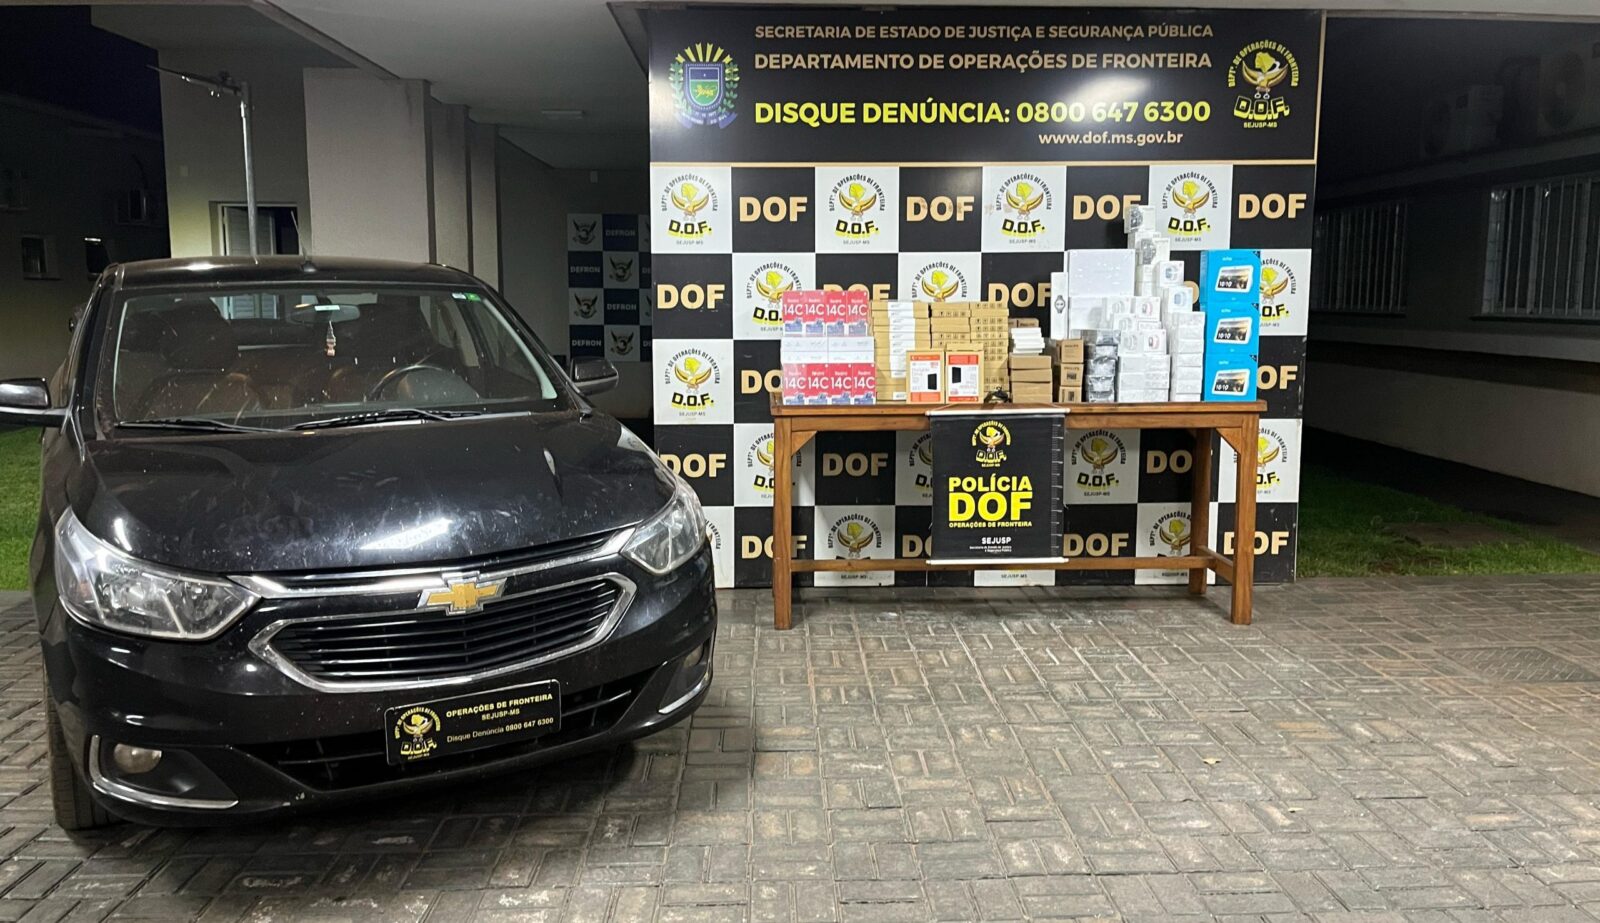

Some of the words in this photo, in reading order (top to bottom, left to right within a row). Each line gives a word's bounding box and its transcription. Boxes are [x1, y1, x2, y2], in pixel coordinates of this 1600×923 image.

[755, 26, 851, 38] SECRETARIA
[855, 26, 876, 38] DE
[879, 26, 941, 38] ESTADO
[944, 26, 965, 38] DE
[968, 26, 1032, 41] JUSTIÇA
[1036, 26, 1045, 38] E
[1049, 25, 1144, 41] SEGURANÇA
[1148, 22, 1213, 38] PÚBLICA
[755, 54, 914, 69] DEPARTAMENTO
[919, 54, 944, 69] DE
[949, 50, 1067, 73] OPERAÇÕES
[1071, 53, 1097, 68] DE
[1102, 53, 1212, 68] FRONTEIRA
[1233, 55, 1242, 65] DE
[1240, 40, 1277, 57] OPERAÇÕES
[1276, 44, 1286, 54] DE
[755, 102, 855, 127] DISQUE
[863, 97, 1010, 123] DENÚNCIA:
[1017, 102, 1085, 123] 0800
[1091, 102, 1138, 122] 647
[1144, 101, 1211, 122] 6300
[1039, 131, 1183, 146] www.dof.ms.gov.br
[740, 197, 807, 222] DOF
[906, 195, 974, 221] DOF
[1239, 194, 1306, 218] DOF
[657, 284, 724, 309] DOF
[784, 304, 803, 316] 14C
[805, 304, 825, 316] 14C
[827, 304, 846, 317] 14C
[848, 304, 868, 317] 14C
[786, 377, 806, 389] 14C
[808, 377, 829, 389] 14C
[832, 377, 852, 389] 14C
[854, 377, 876, 389] 14C
[823, 453, 888, 476] DOF
[949, 473, 1033, 492] POLÍCIA
[949, 491, 1033, 522] DOF
[1064, 533, 1129, 557] DOF
[446, 703, 494, 718] OPERAÇÕES
[497, 701, 507, 709] DE
[509, 693, 553, 707] FRONTEIRA
[482, 708, 520, 720] SEJUSP-MS
[447, 734, 471, 743] Disque
[472, 727, 504, 738] Denúncia
[505, 724, 522, 732] 0800
[523, 720, 536, 729] 647
[537, 717, 554, 726] 6300
